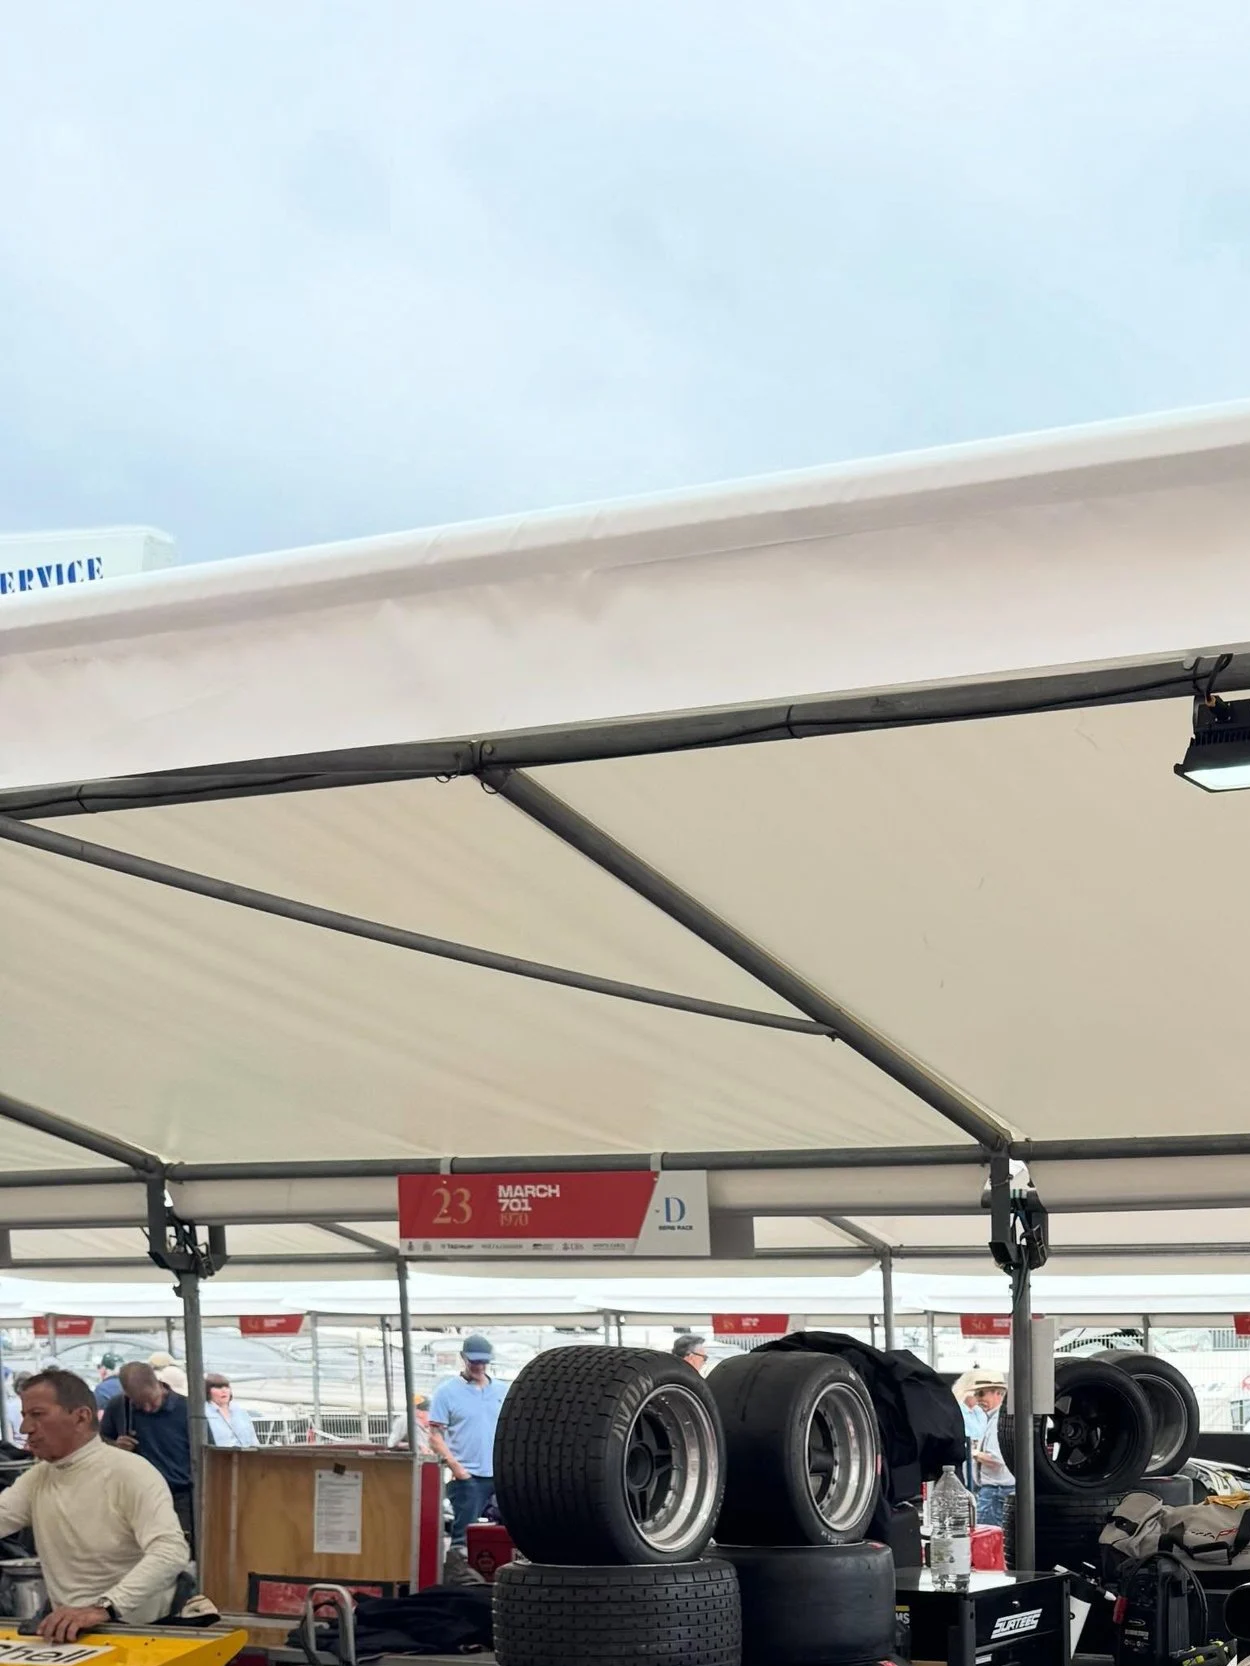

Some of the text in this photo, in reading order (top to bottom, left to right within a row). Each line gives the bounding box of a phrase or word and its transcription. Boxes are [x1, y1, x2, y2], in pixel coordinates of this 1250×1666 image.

[498, 1184, 561, 1198] MARCH
[432, 1187, 473, 1226] 23
[498, 1198, 533, 1212] 701
[665, 1196, 685, 1223] D
[499, 1213, 529, 1226] 1970
[990, 1608, 1043, 1640] SURTEES
